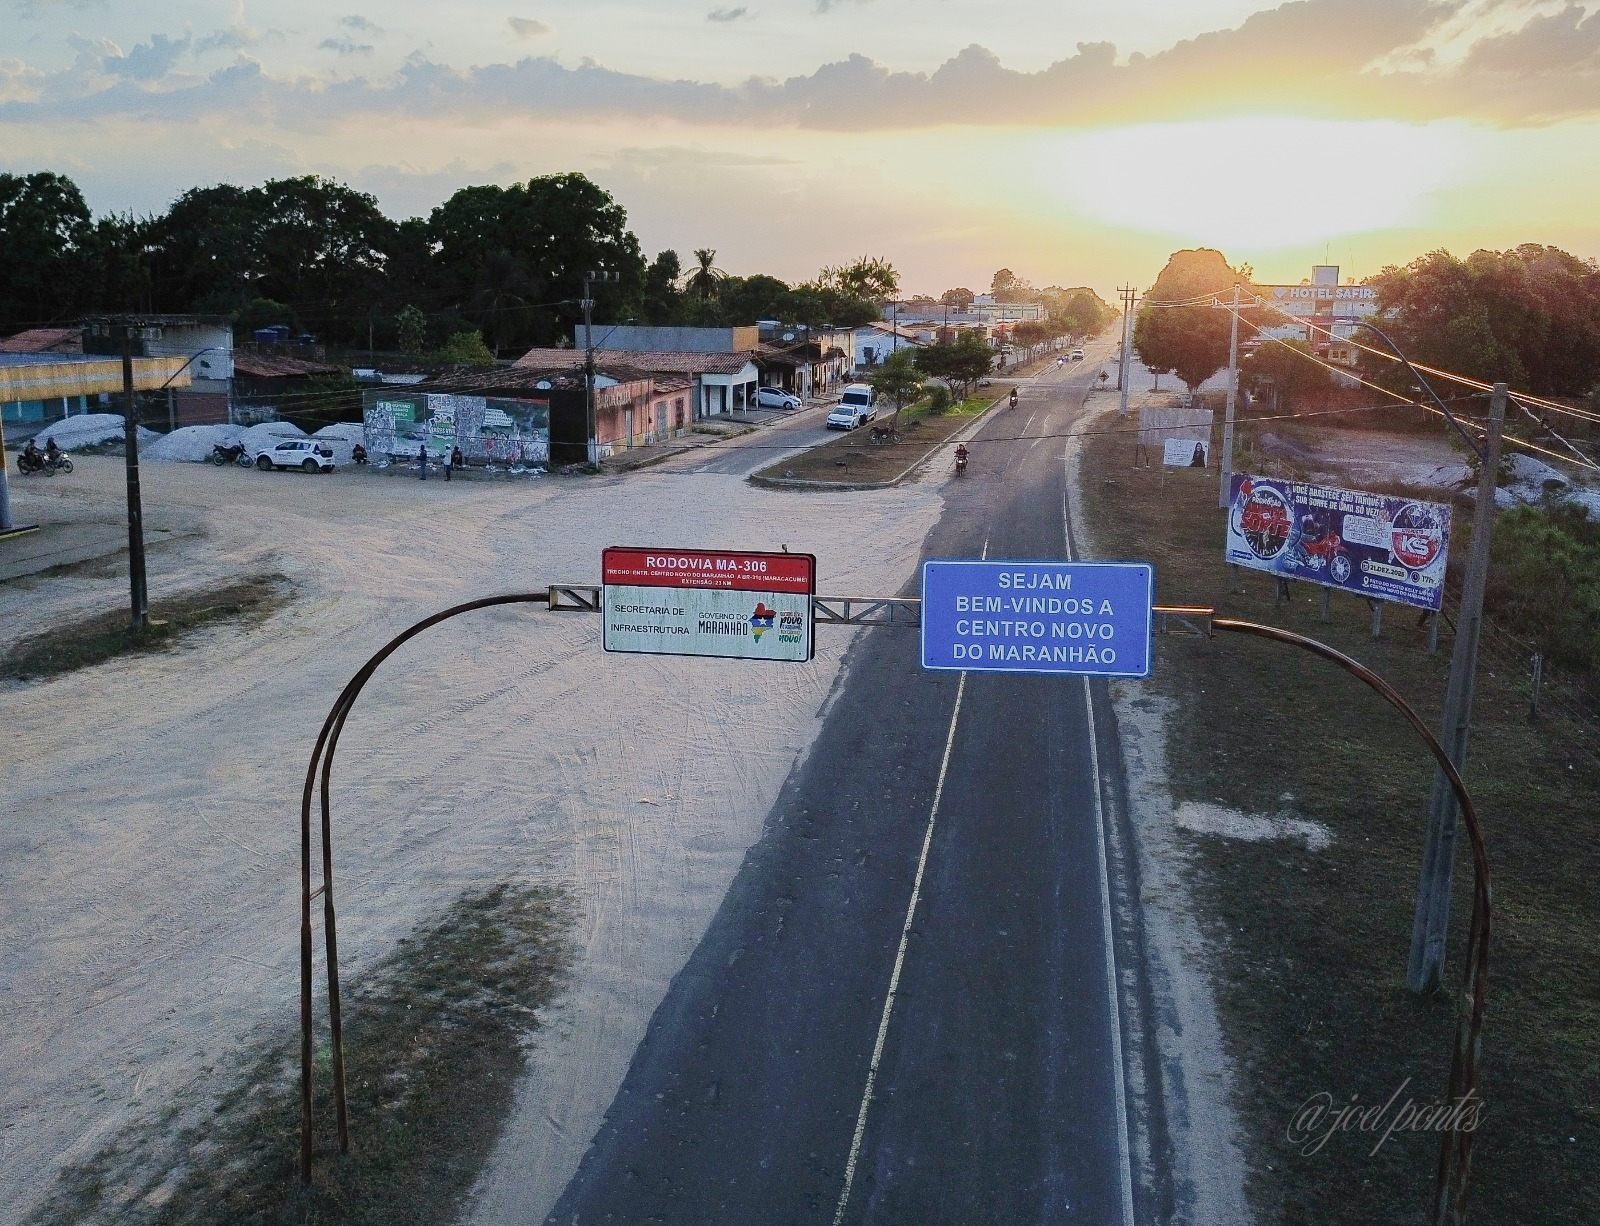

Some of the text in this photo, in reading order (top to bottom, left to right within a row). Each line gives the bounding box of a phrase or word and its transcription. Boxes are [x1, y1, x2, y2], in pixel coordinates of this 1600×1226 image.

[1290, 288, 1332, 298] HOTEL
[1295, 495, 1308, 505] SUA
[1309, 487, 1340, 500] ABASTECE
[1401, 534, 1429, 556] KS
[646, 556, 767, 572] RODOVIA MA-306
[998, 572, 1072, 590] SEJAM
[615, 605, 685, 616] SECRETARIA DE
[956, 596, 1114, 616] BEM-VINDOS A
[698, 612, 748, 621] GOVERNO DO
[611, 624, 690, 635] INFRAESTRUTURA
[698, 620, 748, 636] MARANHÃO
[956, 620, 1114, 640] CENTRO NOVO
[953, 643, 1116, 664] DO MARANHÃO
